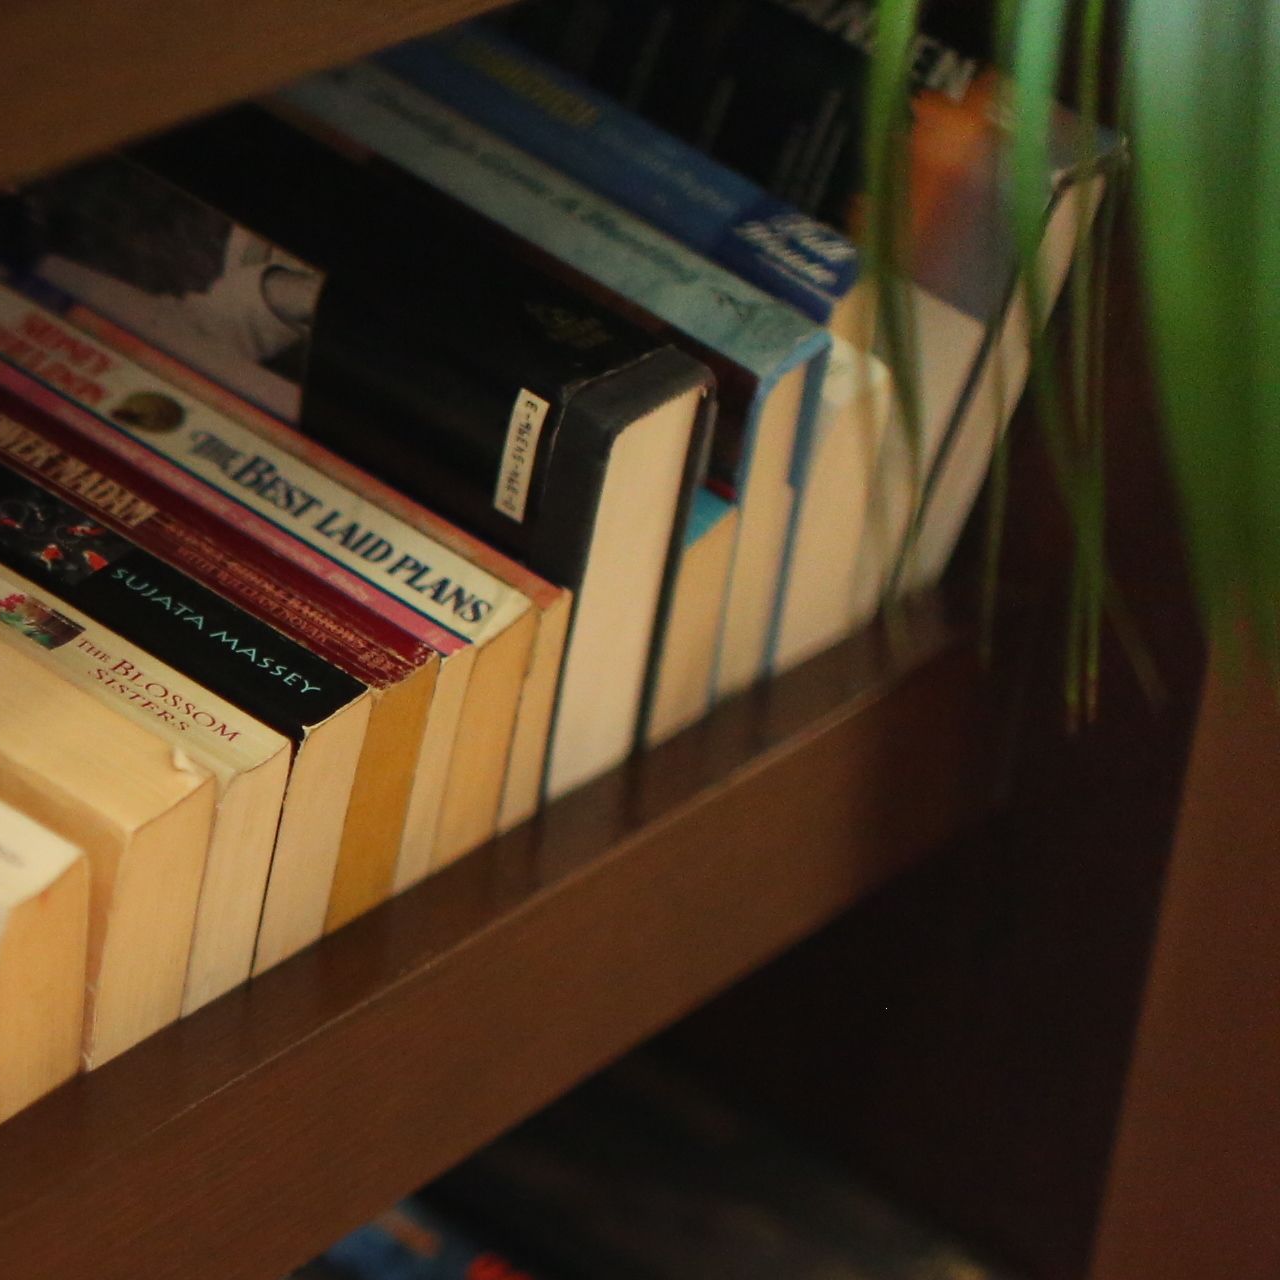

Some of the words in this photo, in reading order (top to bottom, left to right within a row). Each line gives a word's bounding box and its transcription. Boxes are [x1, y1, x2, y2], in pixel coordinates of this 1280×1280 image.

[233, 438, 316, 519] BEST
[312, 508, 389, 573] LAID
[385, 547, 493, 625] PLANS
[75, 637, 113, 670] THE
[110, 656, 241, 744] BLOSSOM
[112, 566, 206, 629] SUJATA
[209, 630, 322, 697] MASSEY
[87, 668, 190, 735] SISTERS
